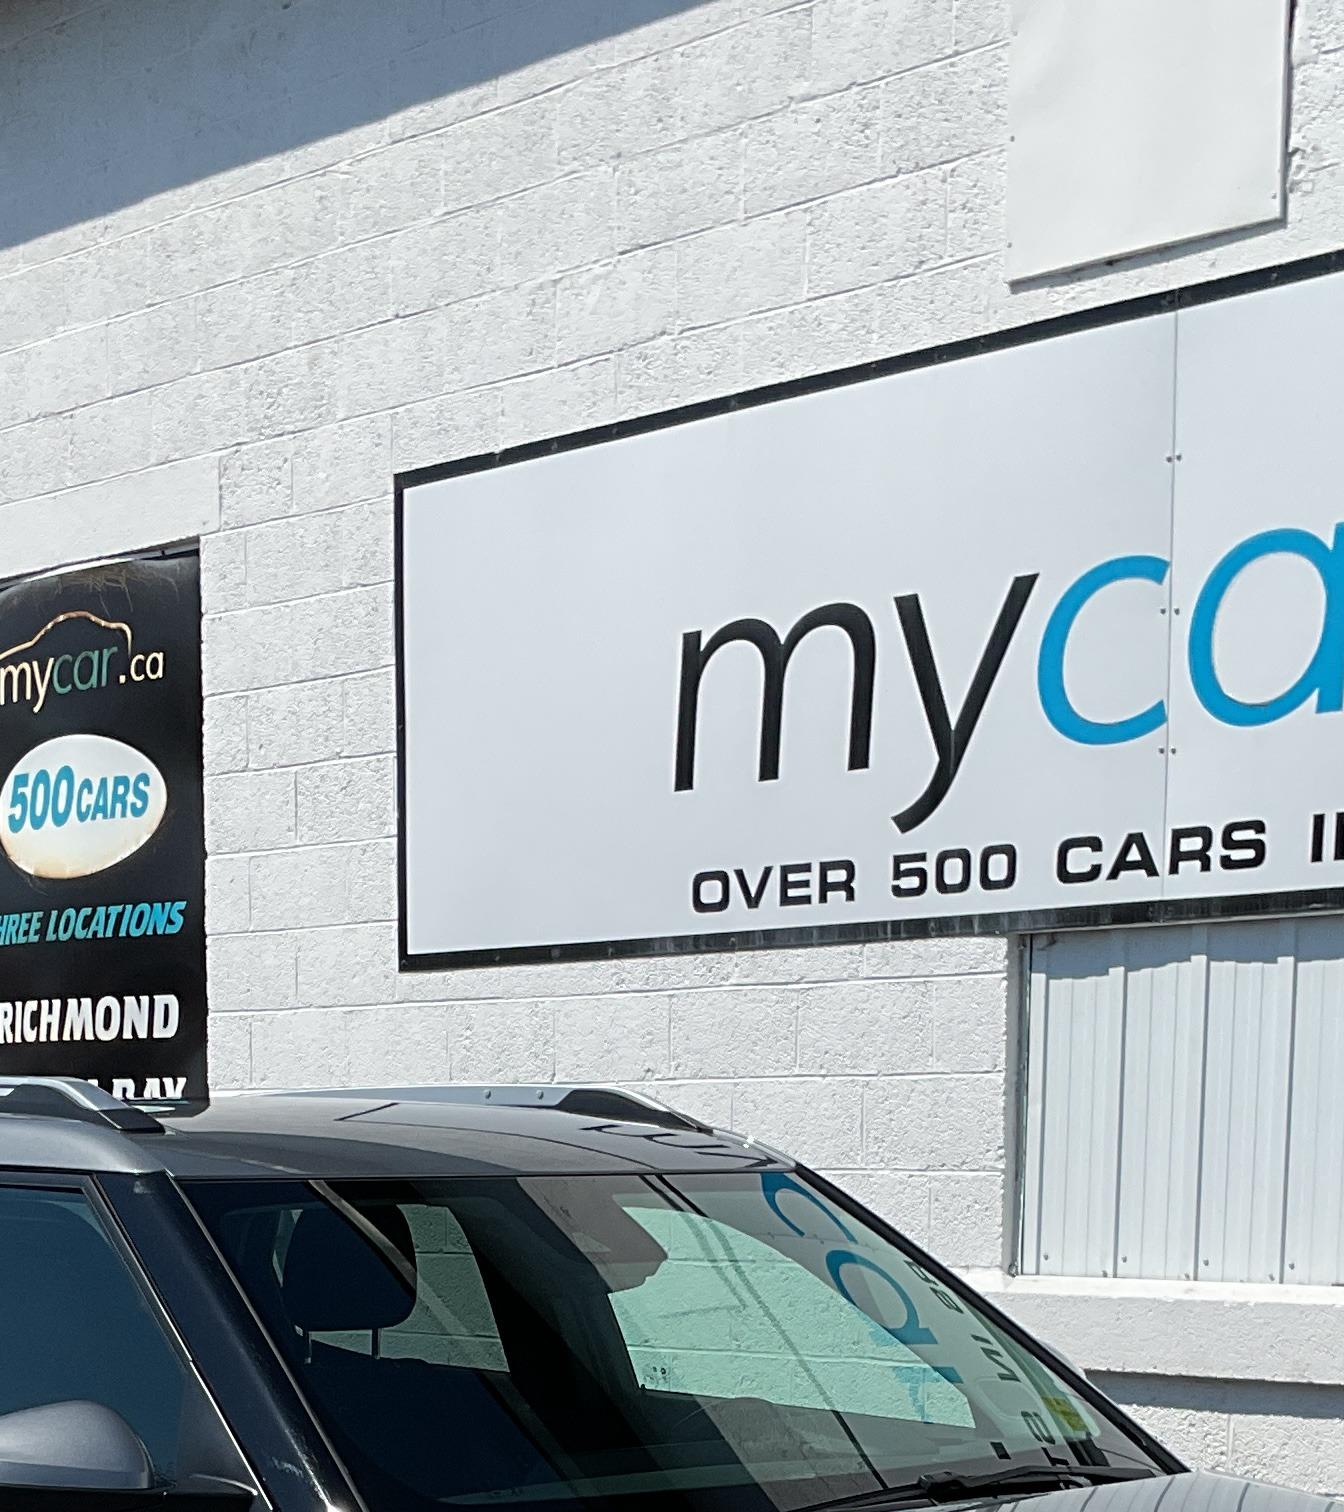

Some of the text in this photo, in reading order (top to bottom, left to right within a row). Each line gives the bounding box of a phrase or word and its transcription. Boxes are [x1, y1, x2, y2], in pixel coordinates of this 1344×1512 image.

[7, 764, 151, 835] 500 CARS
[692, 852, 856, 913] OVER
[890, 844, 1017, 898] 500
[1056, 820, 1266, 884] CARS
[45, 900, 188, 942] LOCATIONS
